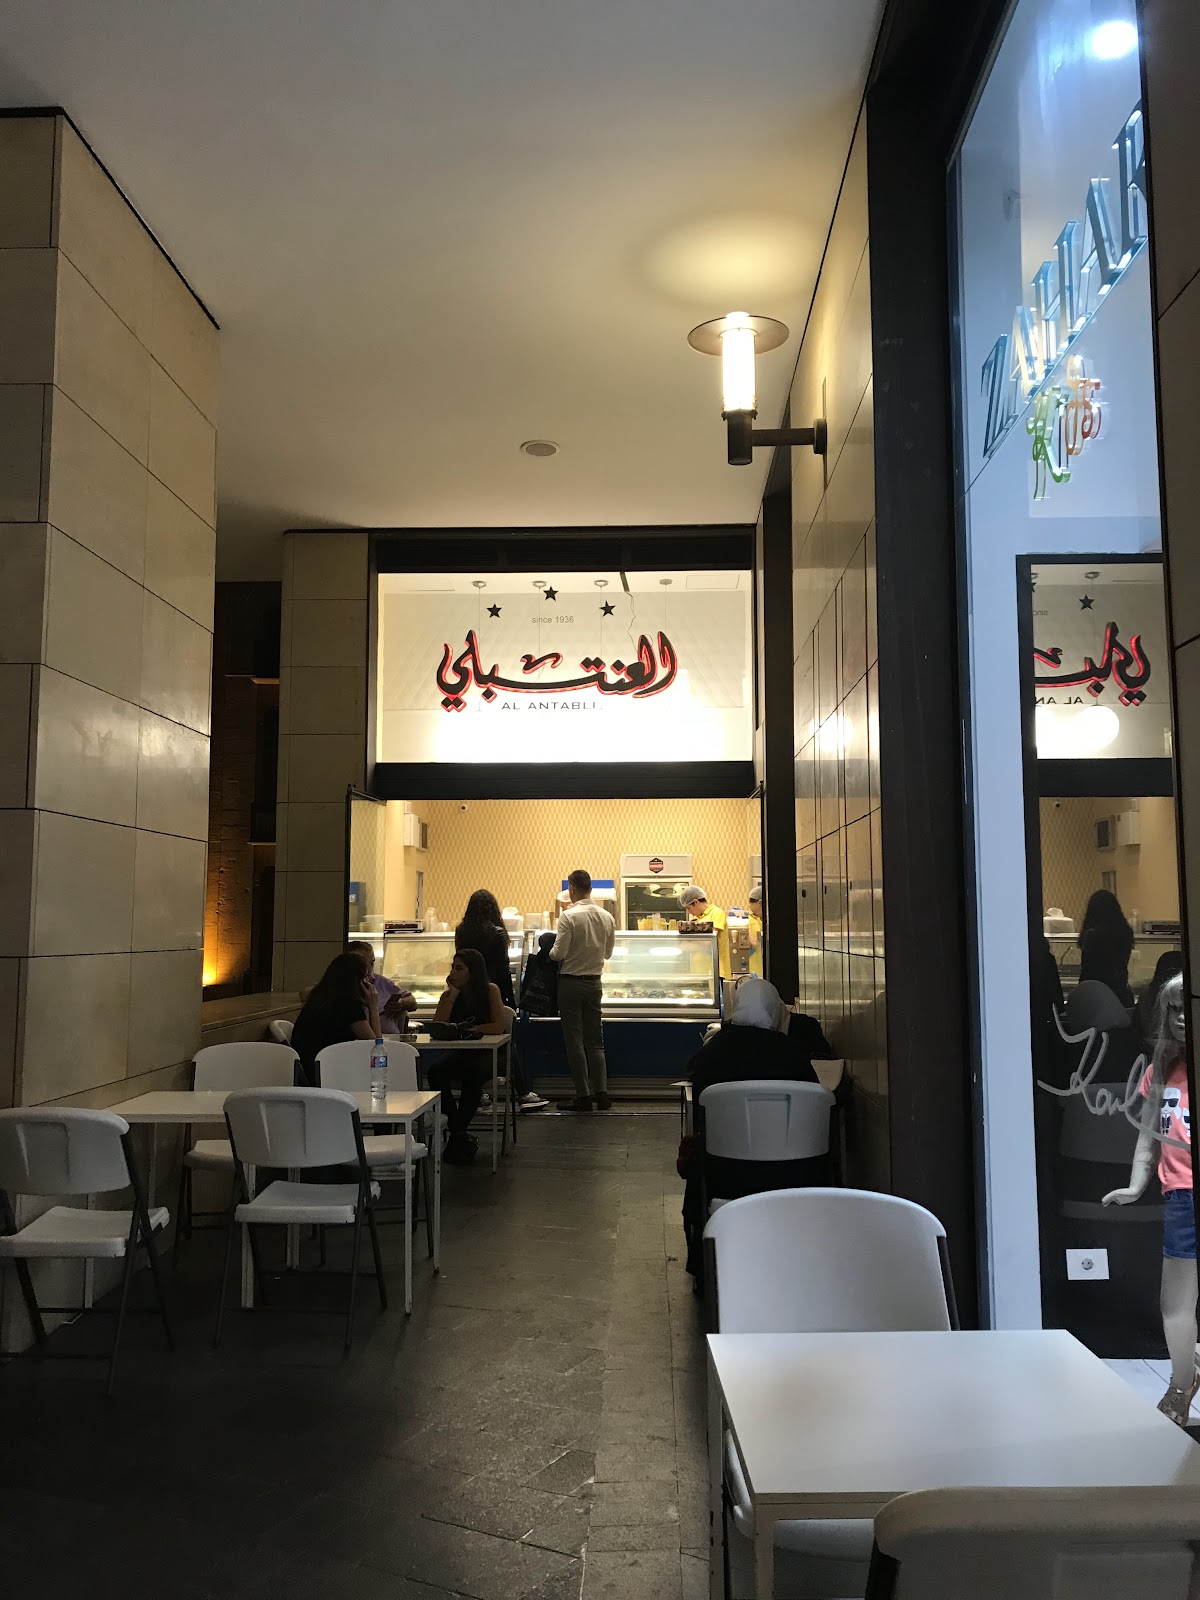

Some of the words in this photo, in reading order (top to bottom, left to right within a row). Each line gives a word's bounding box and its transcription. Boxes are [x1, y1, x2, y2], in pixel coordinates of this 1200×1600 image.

[555, 616, 574, 624] 1936
[436, 629, 677, 712] العنتبلي
[502, 702, 520, 710] AL
[528, 702, 596, 710] ANTABLI
